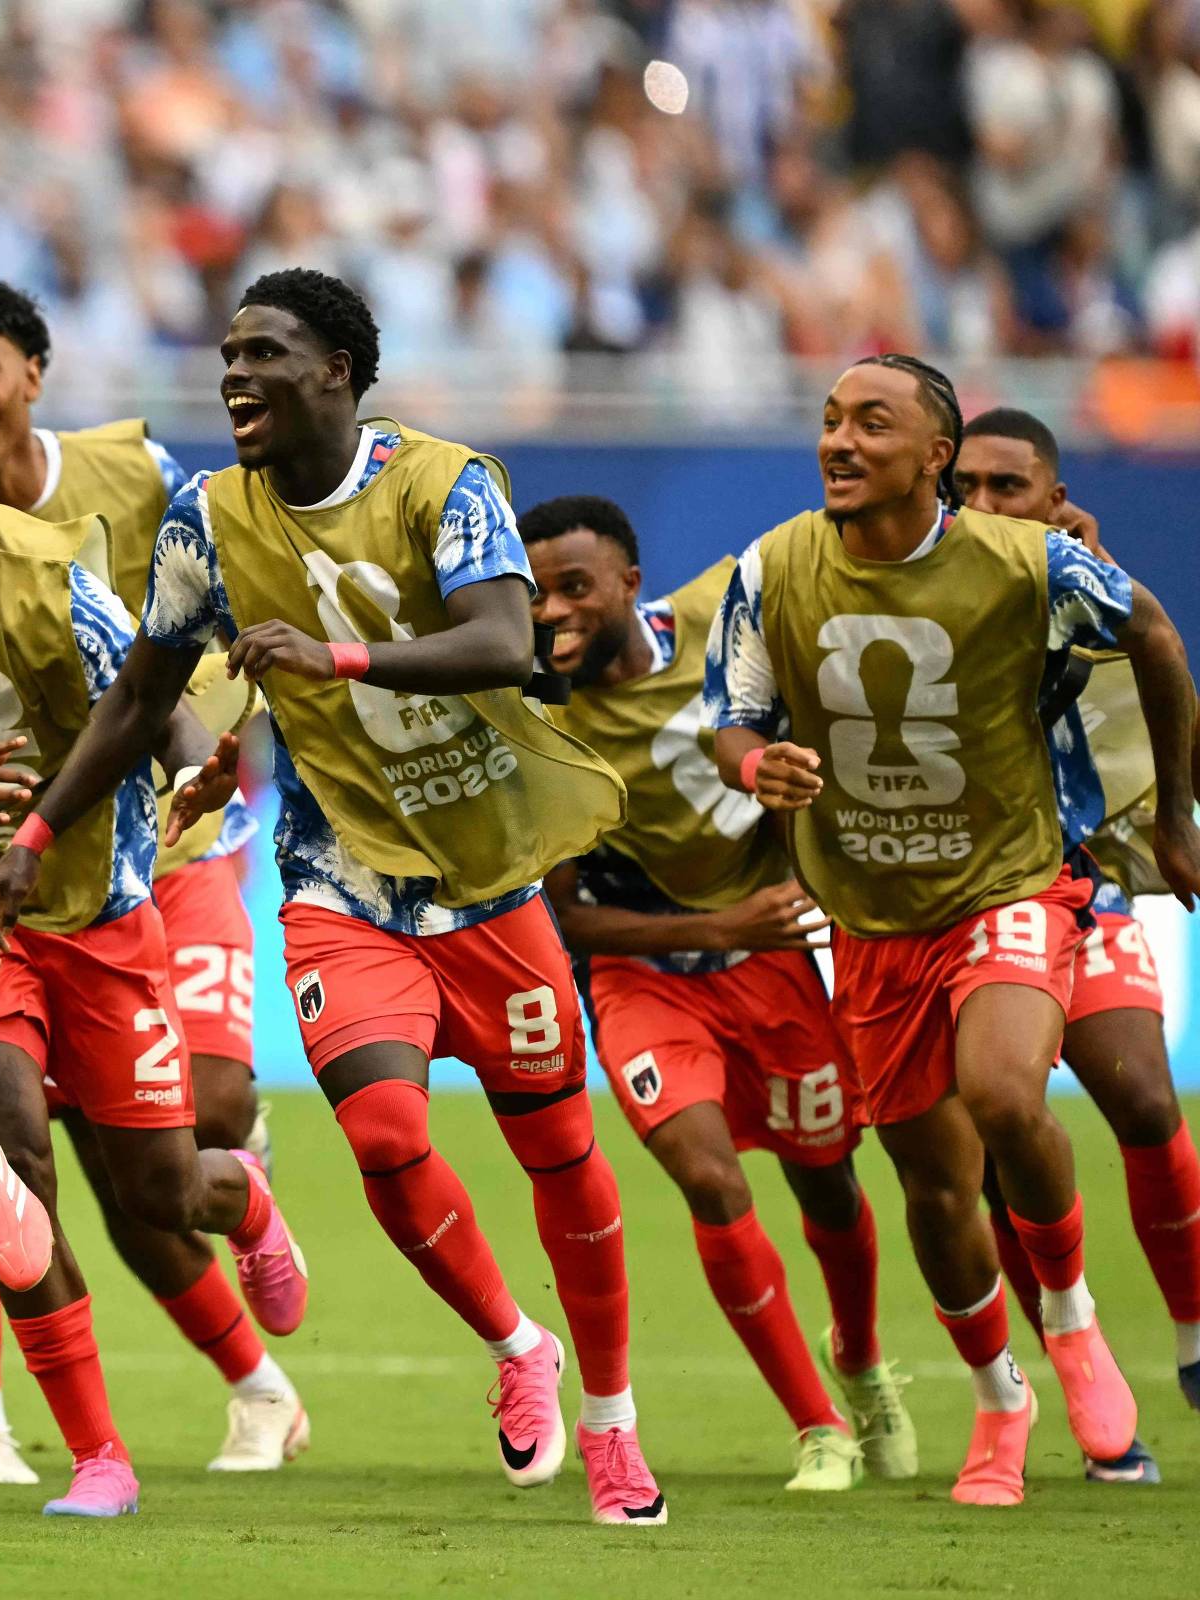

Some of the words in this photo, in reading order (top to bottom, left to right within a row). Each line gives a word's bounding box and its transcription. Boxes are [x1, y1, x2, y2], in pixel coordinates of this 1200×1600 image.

[381, 752, 462, 784] WORLD
[464, 726, 501, 757] CUP
[393, 745, 518, 816] 2026
[867, 773, 929, 792] FIFA
[835, 809, 919, 832] WORLD
[923, 812, 971, 830] CUP
[837, 831, 974, 865] 2026
[296, 971, 317, 992] FCF
[505, 985, 560, 1055] 8
[134, 1008, 180, 1082] 2
[510, 1053, 565, 1073] capelli
[134, 1085, 182, 1105] capelli
[766, 1062, 844, 1132] 16
